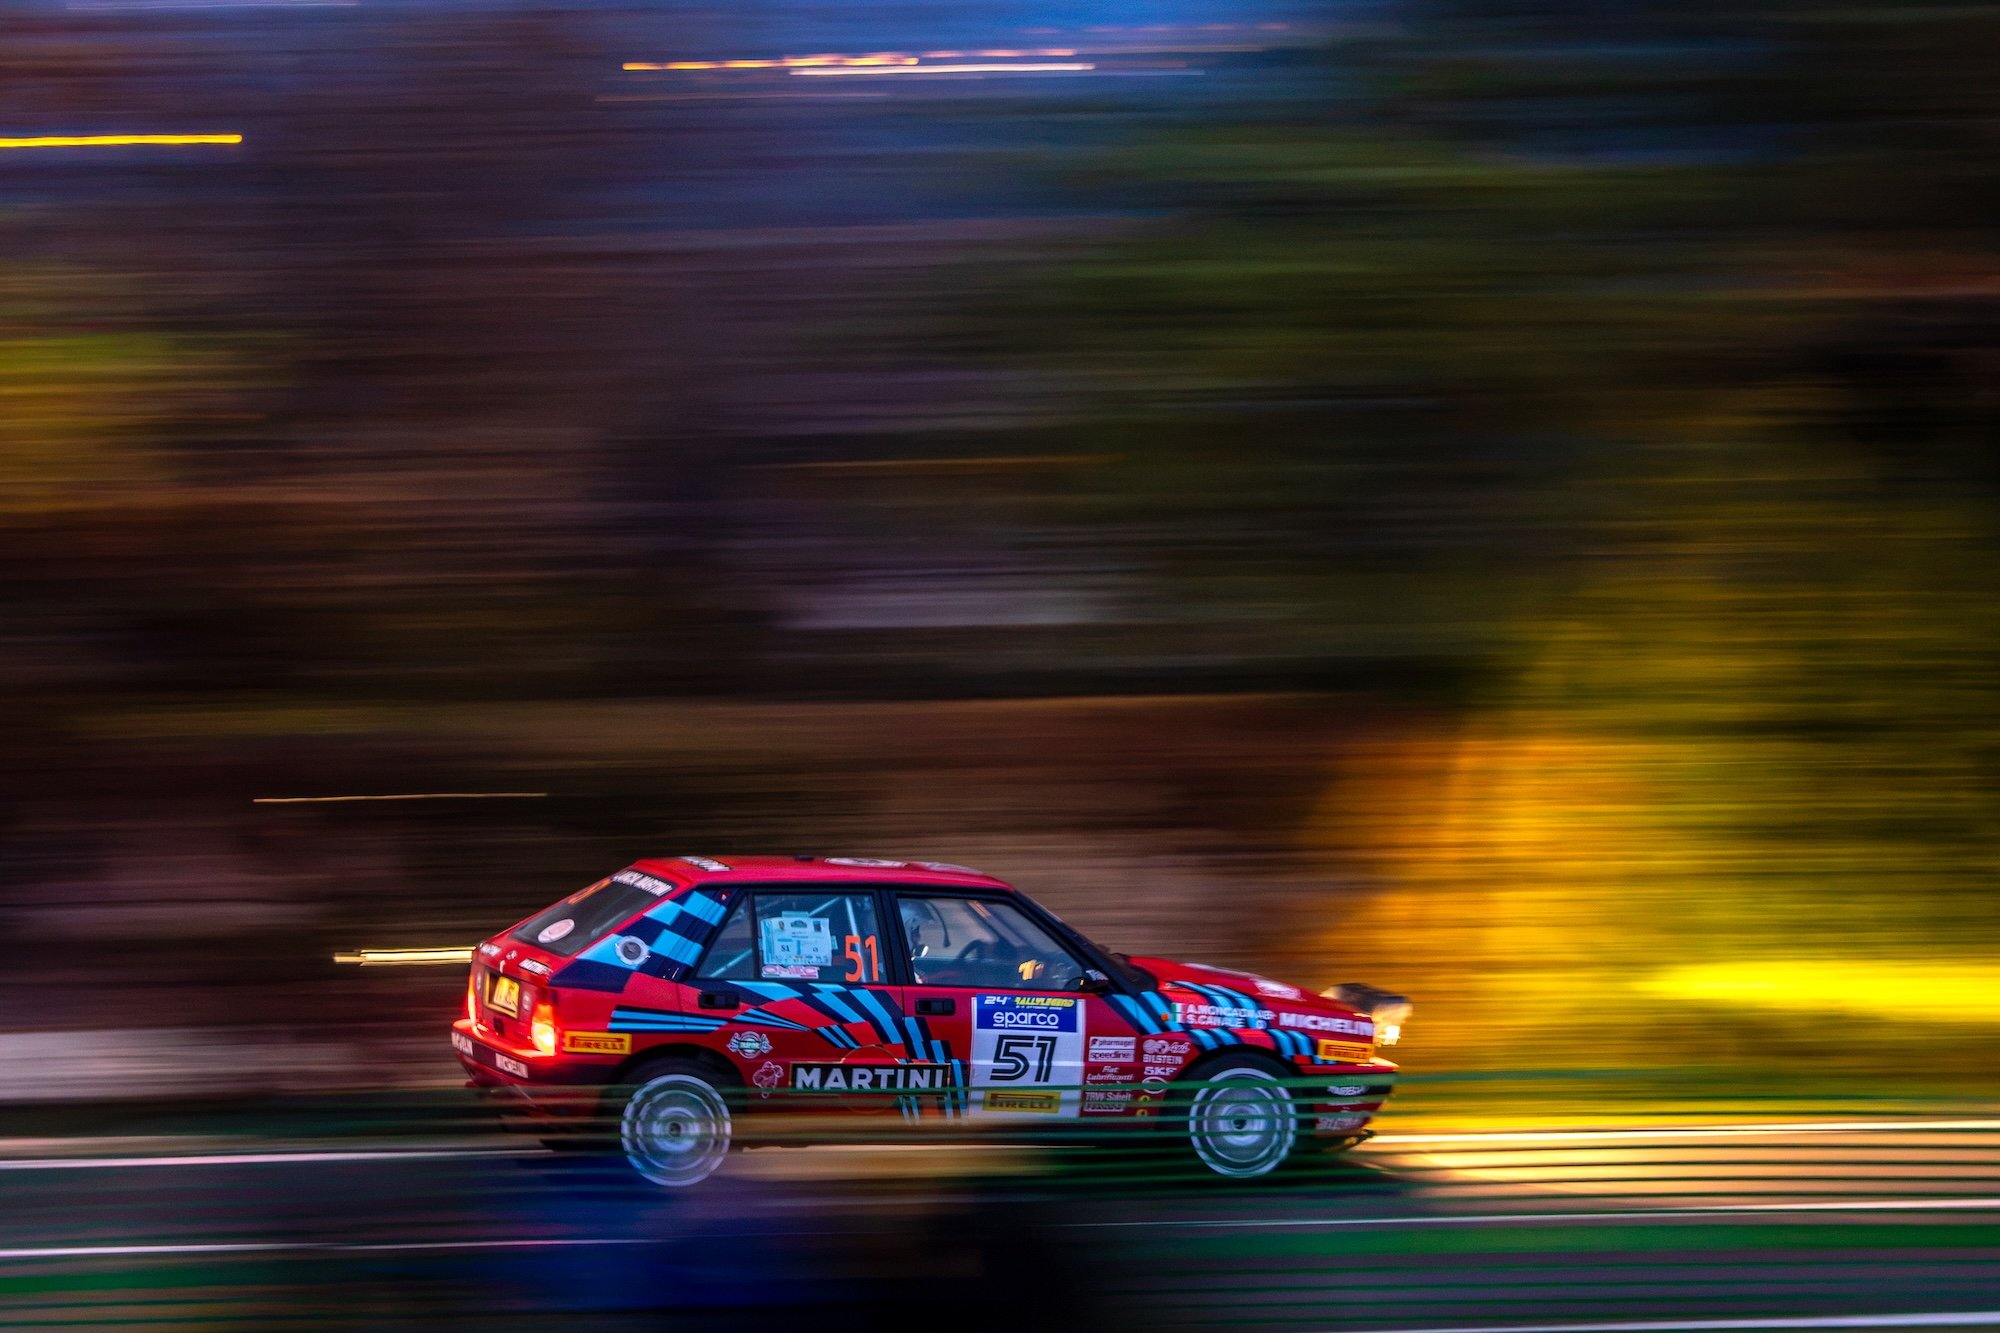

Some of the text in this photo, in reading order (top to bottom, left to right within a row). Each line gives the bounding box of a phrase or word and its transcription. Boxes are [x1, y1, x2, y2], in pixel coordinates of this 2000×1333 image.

[845, 935, 879, 982] 51
[993, 1012, 1059, 1028] sparco
[1279, 1012, 1374, 1037] MICHELIN
[569, 1036, 625, 1050] PIRELLI
[989, 1034, 1058, 1083] 51
[1142, 1054, 1184, 1064] BILSTEIN
[796, 1067, 944, 1090] MARTINI
[1143, 1067, 1178, 1076] SKF
[989, 1093, 1055, 1109] PIRELLI
